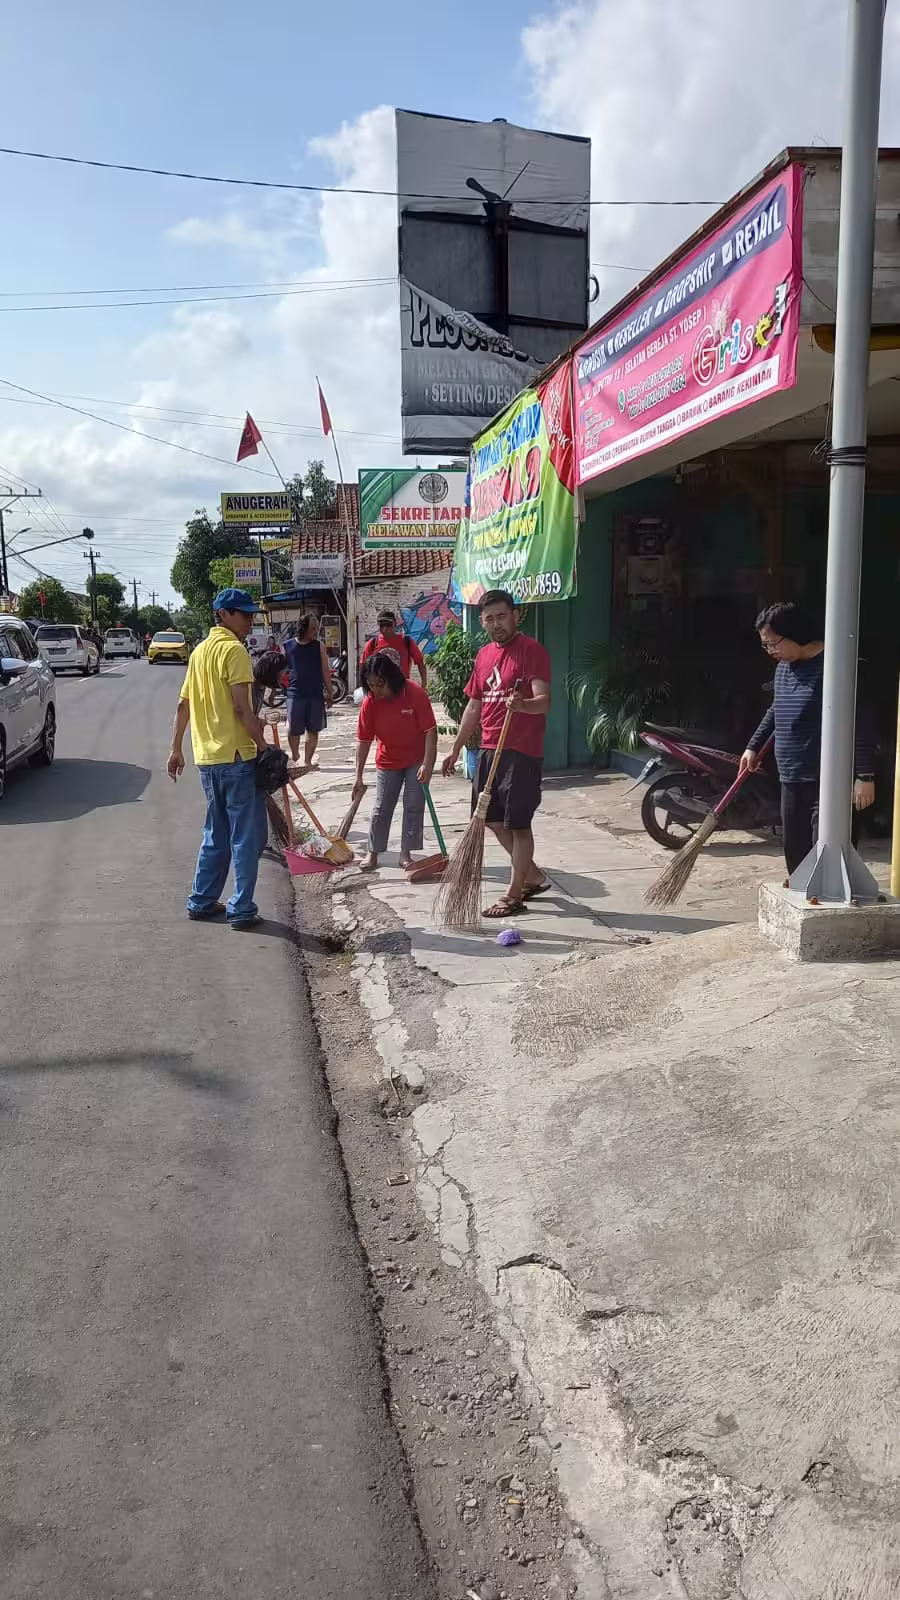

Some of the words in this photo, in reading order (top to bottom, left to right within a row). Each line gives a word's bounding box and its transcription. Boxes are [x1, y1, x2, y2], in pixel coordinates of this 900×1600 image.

[614, 305, 652, 352] RESELLER
[663, 252, 715, 314] DROPSHIP
[735, 202, 782, 260] RETAIL
[624, 348, 646, 374] SELATAN
[647, 333, 669, 359] GEREJA
[679, 308, 702, 336] YOSEP
[657, 417, 676, 434] TANGGA
[708, 387, 735, 408] BARANG
[736, 367, 773, 394] KEKINIAN
[226, 495, 289, 510] ANUGERAH
[381, 507, 462, 521] SEKRETAR
[367, 524, 427, 537] RELAWAN
[235, 569, 257, 577] SERVICE
